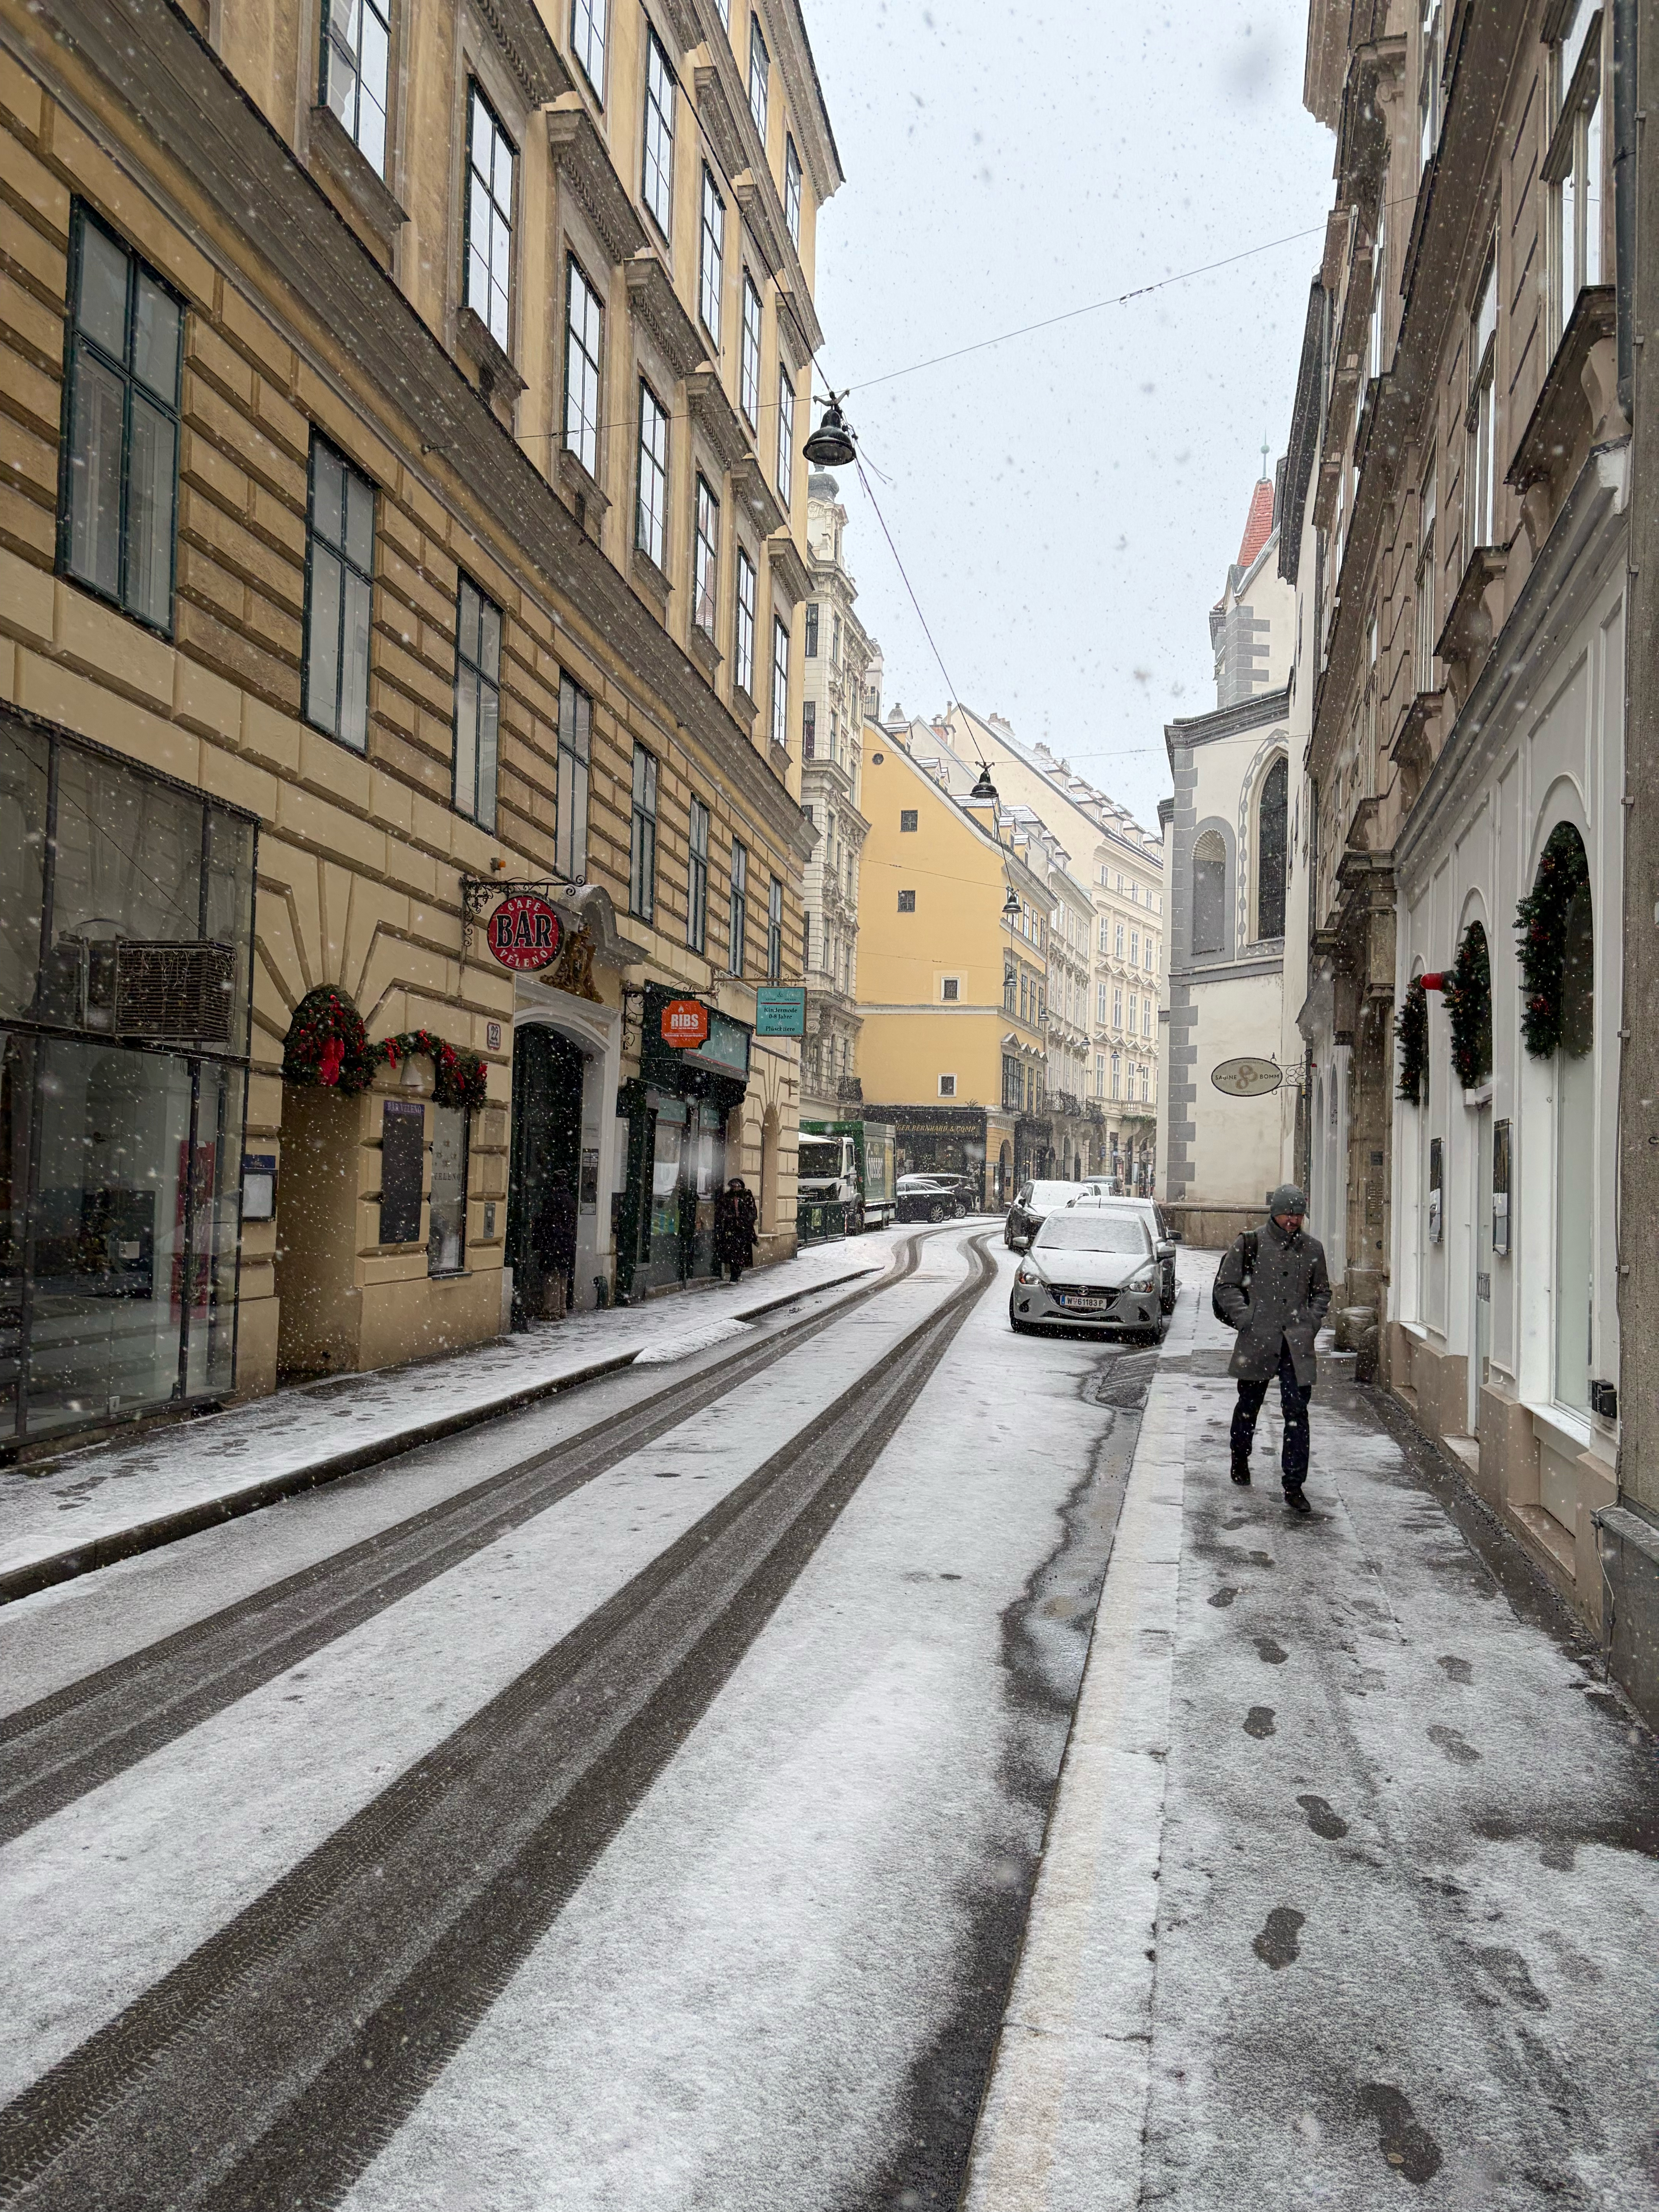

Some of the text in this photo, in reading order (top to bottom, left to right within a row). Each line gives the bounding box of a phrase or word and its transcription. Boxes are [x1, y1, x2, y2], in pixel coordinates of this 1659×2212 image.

[508, 900, 541, 911] CAFE
[496, 910, 553, 948] BAR
[500, 949, 548, 967] VELENO
[671, 1014, 699, 1027] RIBS
[491, 1025, 498, 1041] 22
